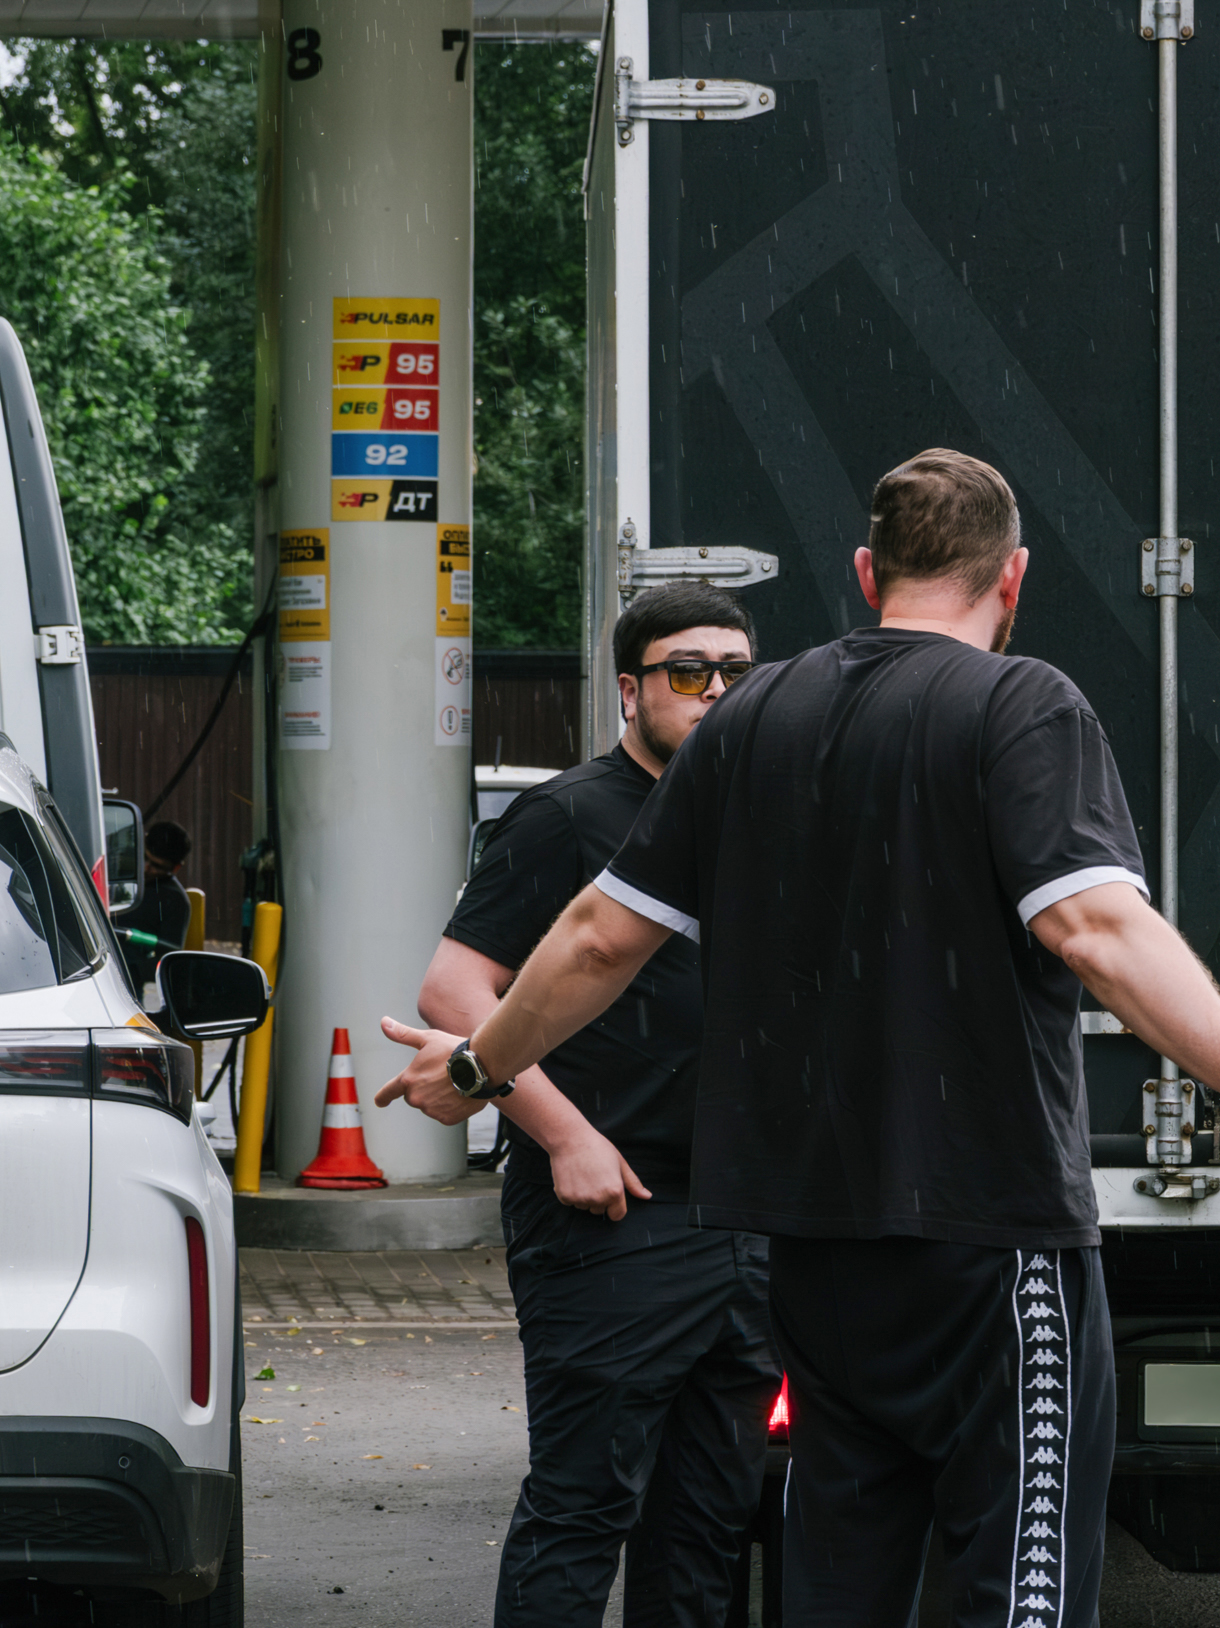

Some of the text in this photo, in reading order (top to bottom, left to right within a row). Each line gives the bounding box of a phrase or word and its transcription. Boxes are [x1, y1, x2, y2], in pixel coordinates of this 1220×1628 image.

[287, 27, 323, 81] 8
[442, 28, 471, 82] 7
[353, 312, 435, 326] PULSAR
[396, 353, 435, 375] 95
[393, 399, 431, 420] 95
[365, 443, 409, 466] 92
[393, 491, 433, 513] ДТ
